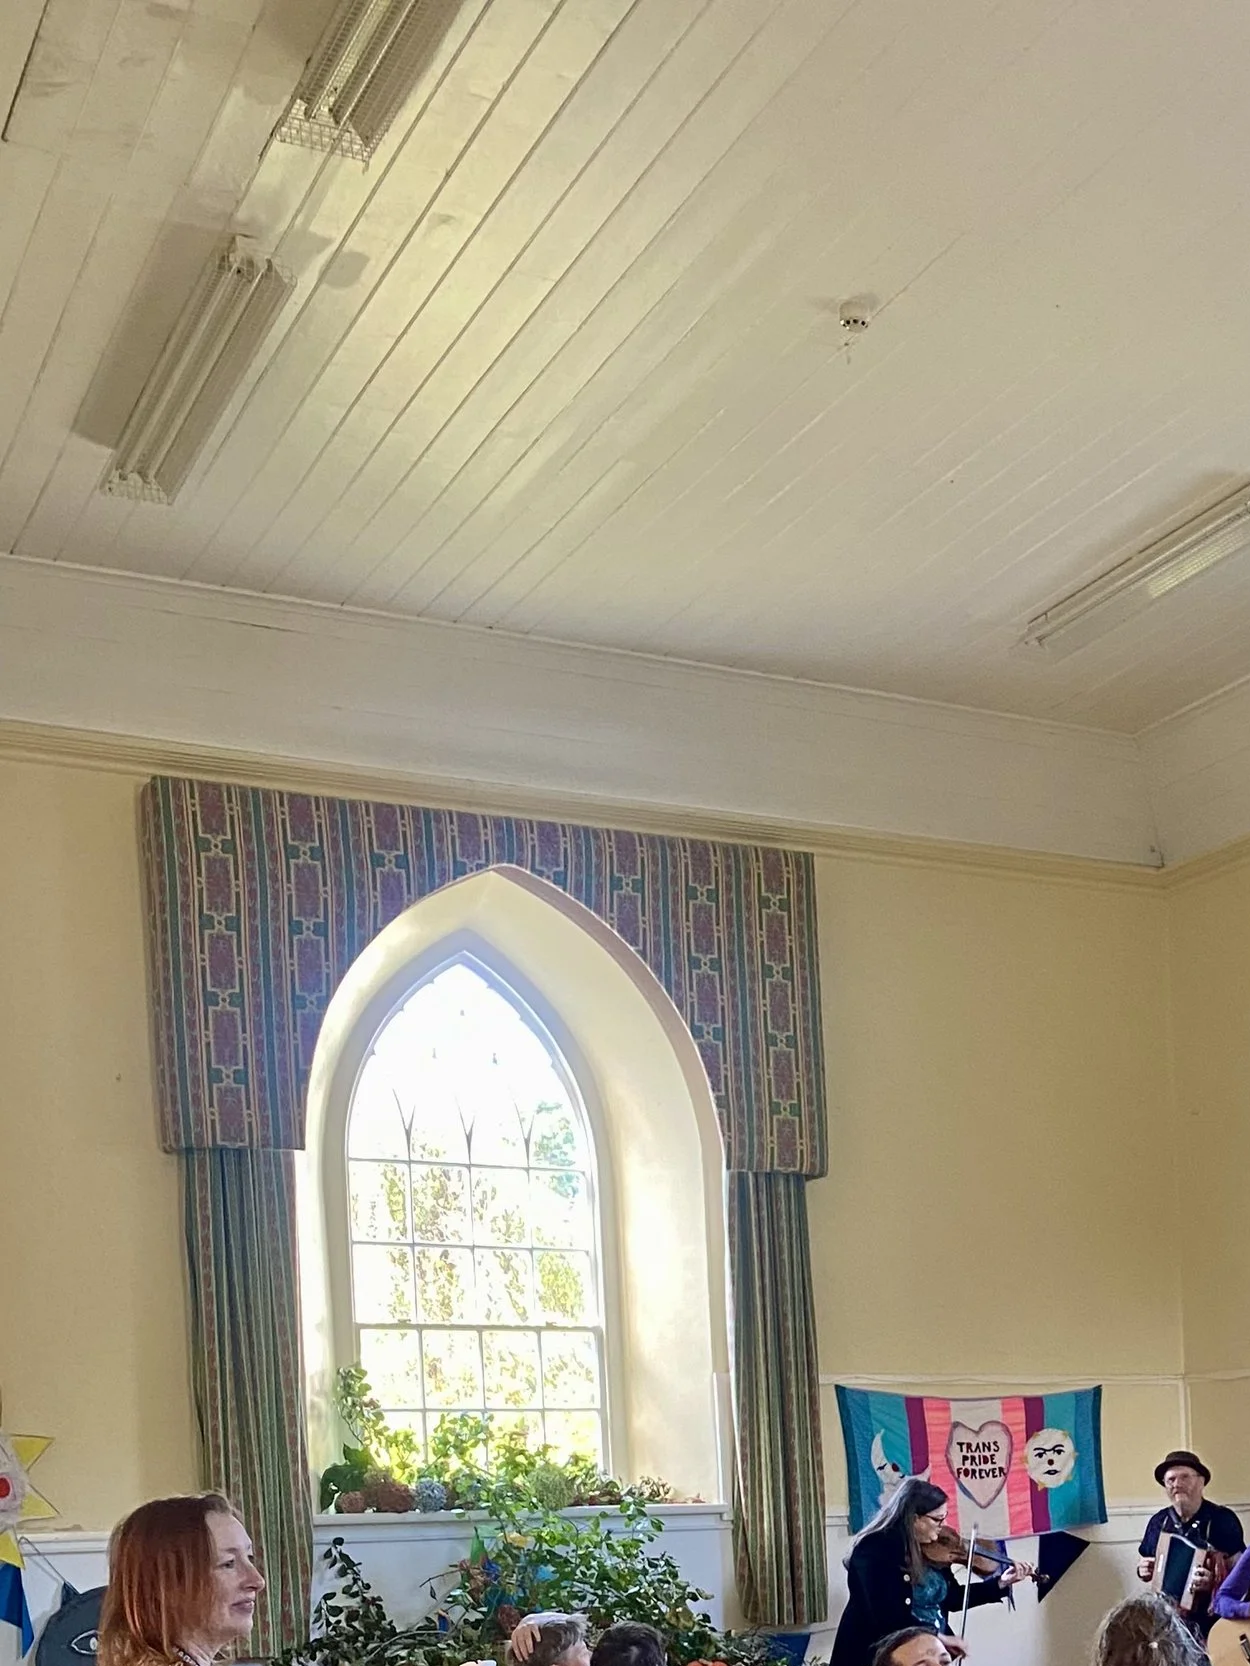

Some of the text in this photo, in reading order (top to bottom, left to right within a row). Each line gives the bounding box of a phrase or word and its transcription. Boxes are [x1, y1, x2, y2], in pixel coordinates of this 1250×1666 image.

[956, 1440, 1000, 1453] TRANS
[961, 1453, 997, 1467] PRIDE
[956, 1466, 1007, 1480] FOREVER
